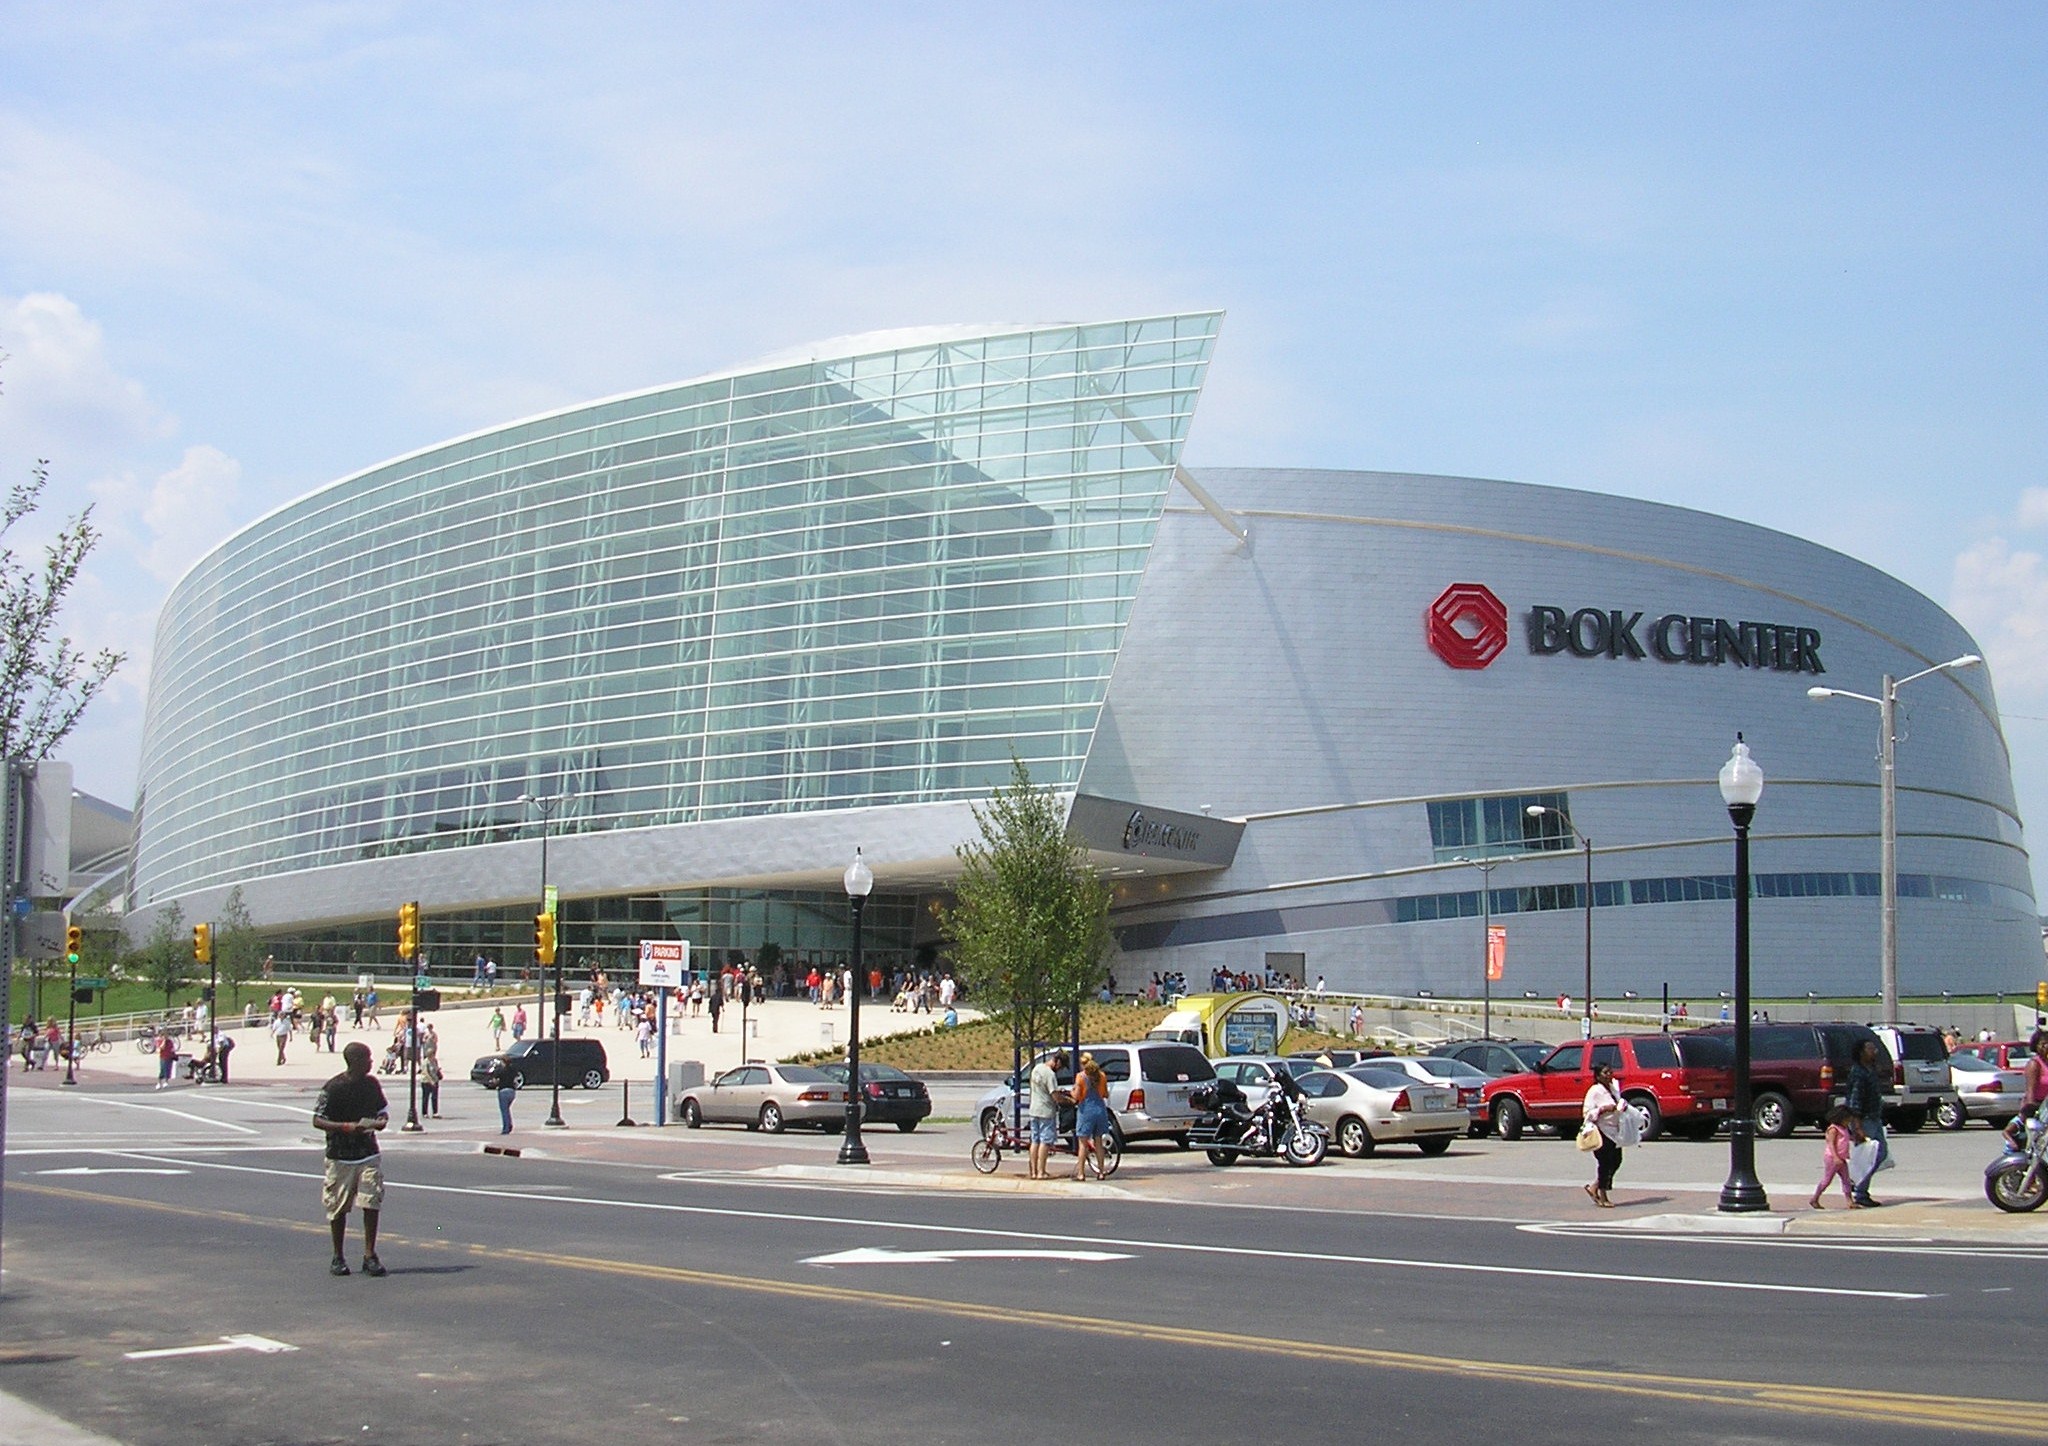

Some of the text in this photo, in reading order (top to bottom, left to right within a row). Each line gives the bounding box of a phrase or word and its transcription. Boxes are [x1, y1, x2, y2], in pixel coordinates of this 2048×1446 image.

[1529, 605, 1826, 674] BOK CENTER
[653, 946, 680, 958] PARKING
